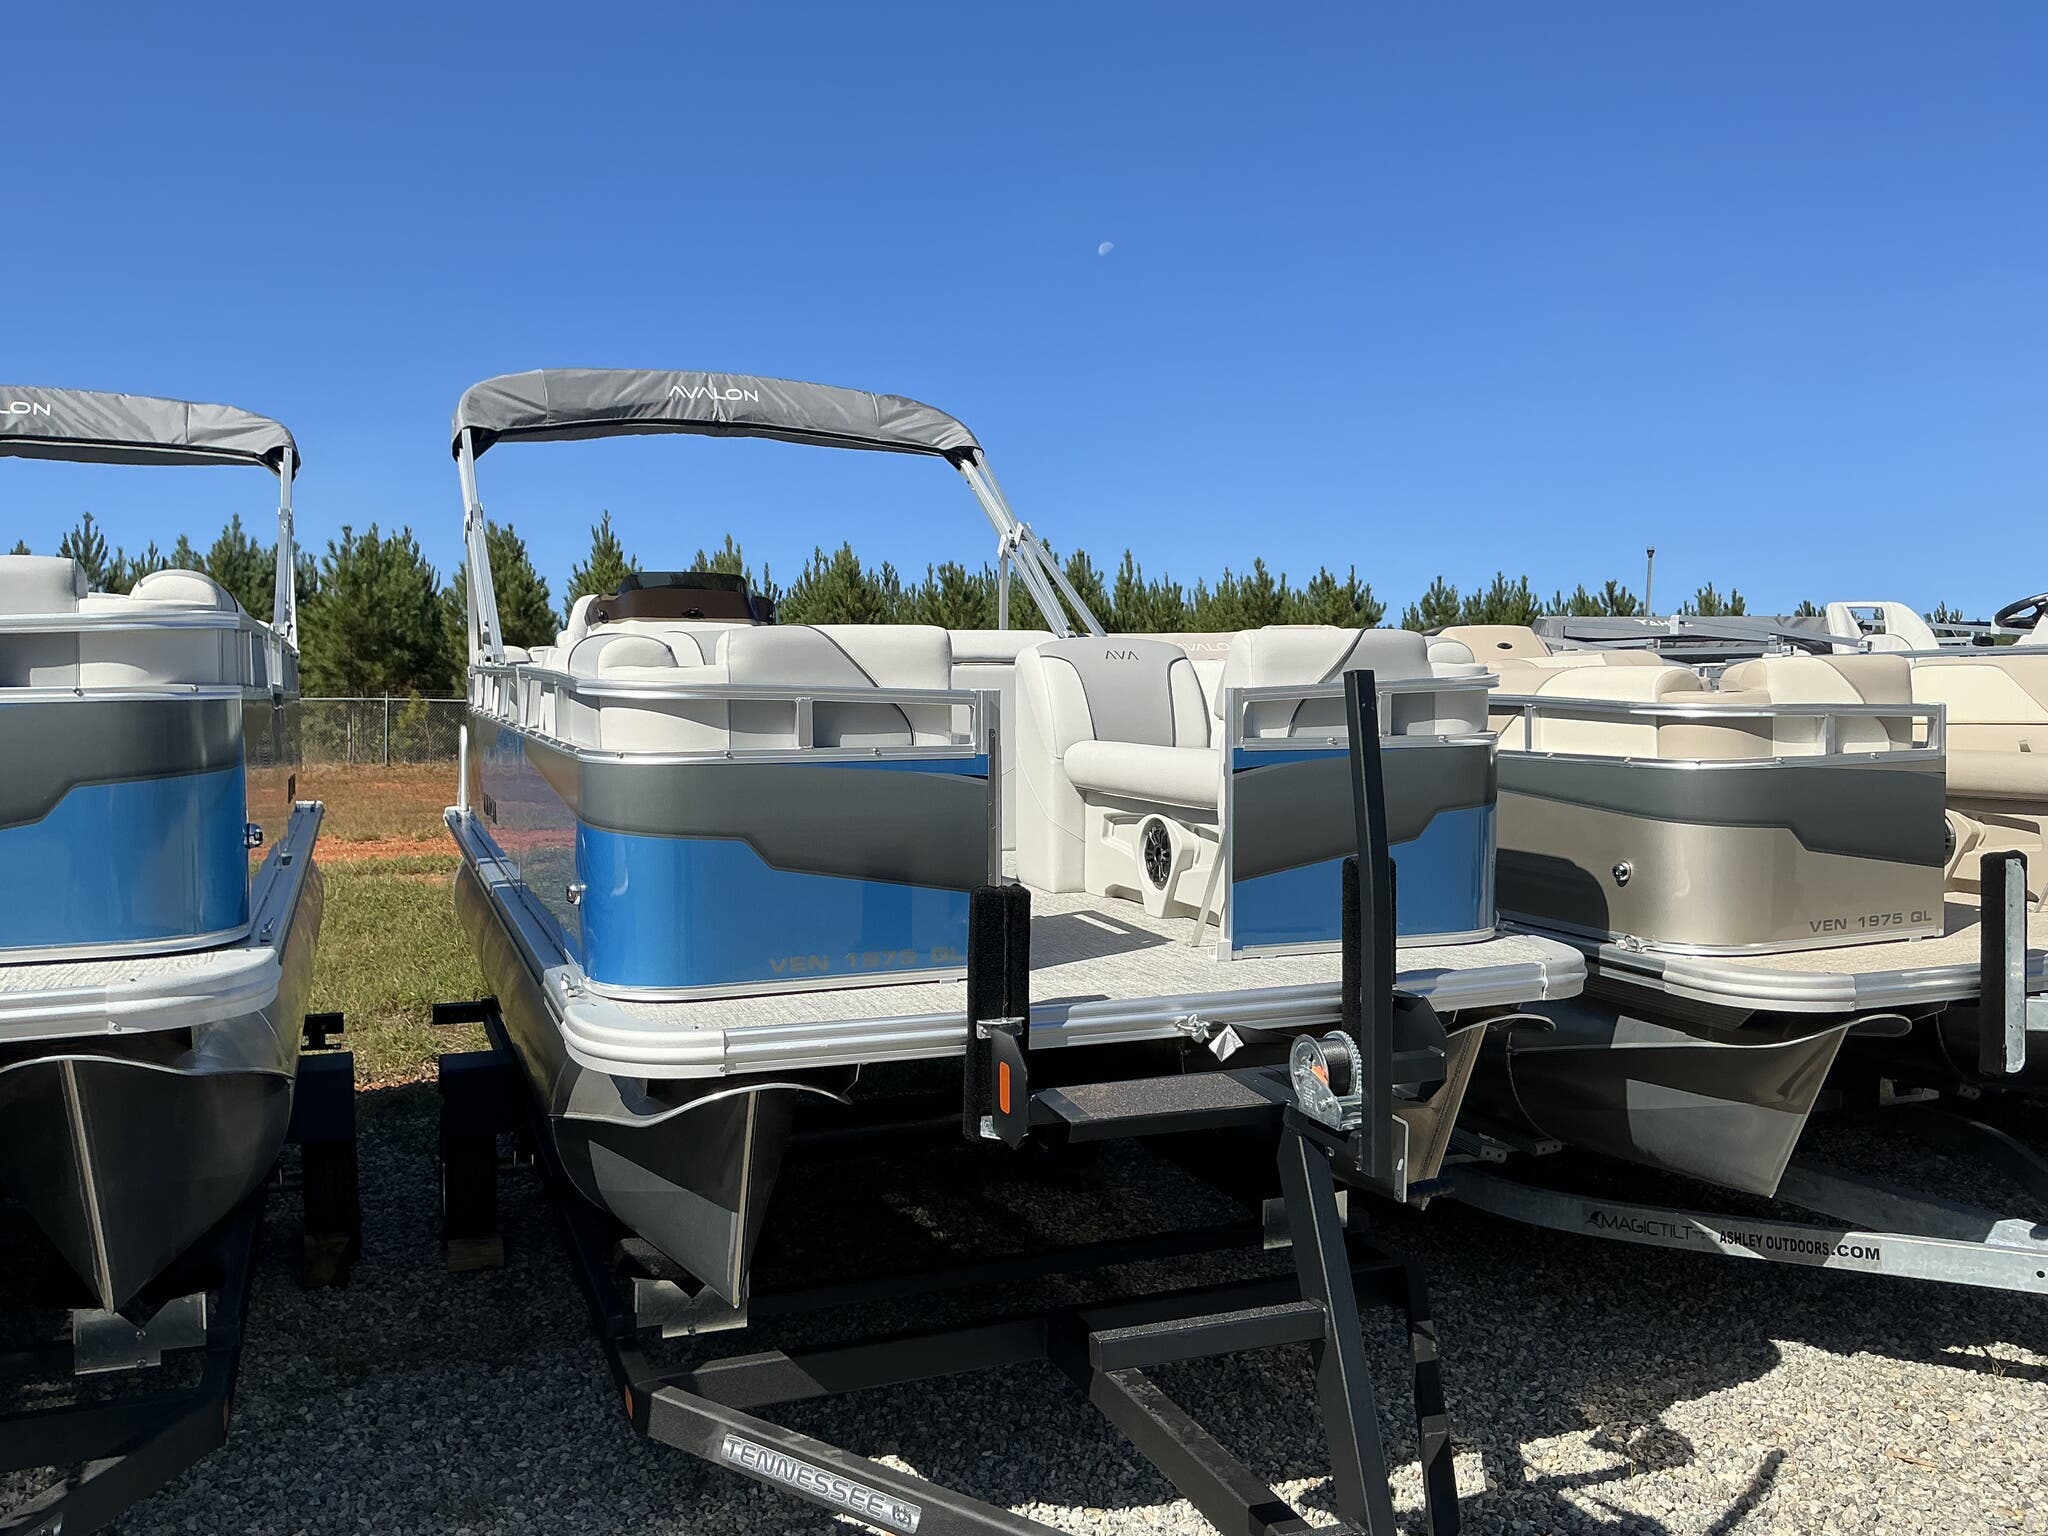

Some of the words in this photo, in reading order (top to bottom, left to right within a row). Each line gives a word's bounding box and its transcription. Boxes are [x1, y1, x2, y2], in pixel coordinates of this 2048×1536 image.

[668, 385, 759, 403] AVALON
[1633, 618, 1694, 629] TAH
[1105, 650, 1140, 661] AVA
[1176, 642, 1233, 652] AVALO
[1809, 917, 1848, 933] VEN
[1858, 912, 1903, 929] 1975
[769, 954, 830, 974] VEN
[1600, 1213, 1693, 1241] MAGICTILT
[1719, 1230, 1764, 1248] ASHLEY
[726, 1437, 888, 1519] TENNESSEE
